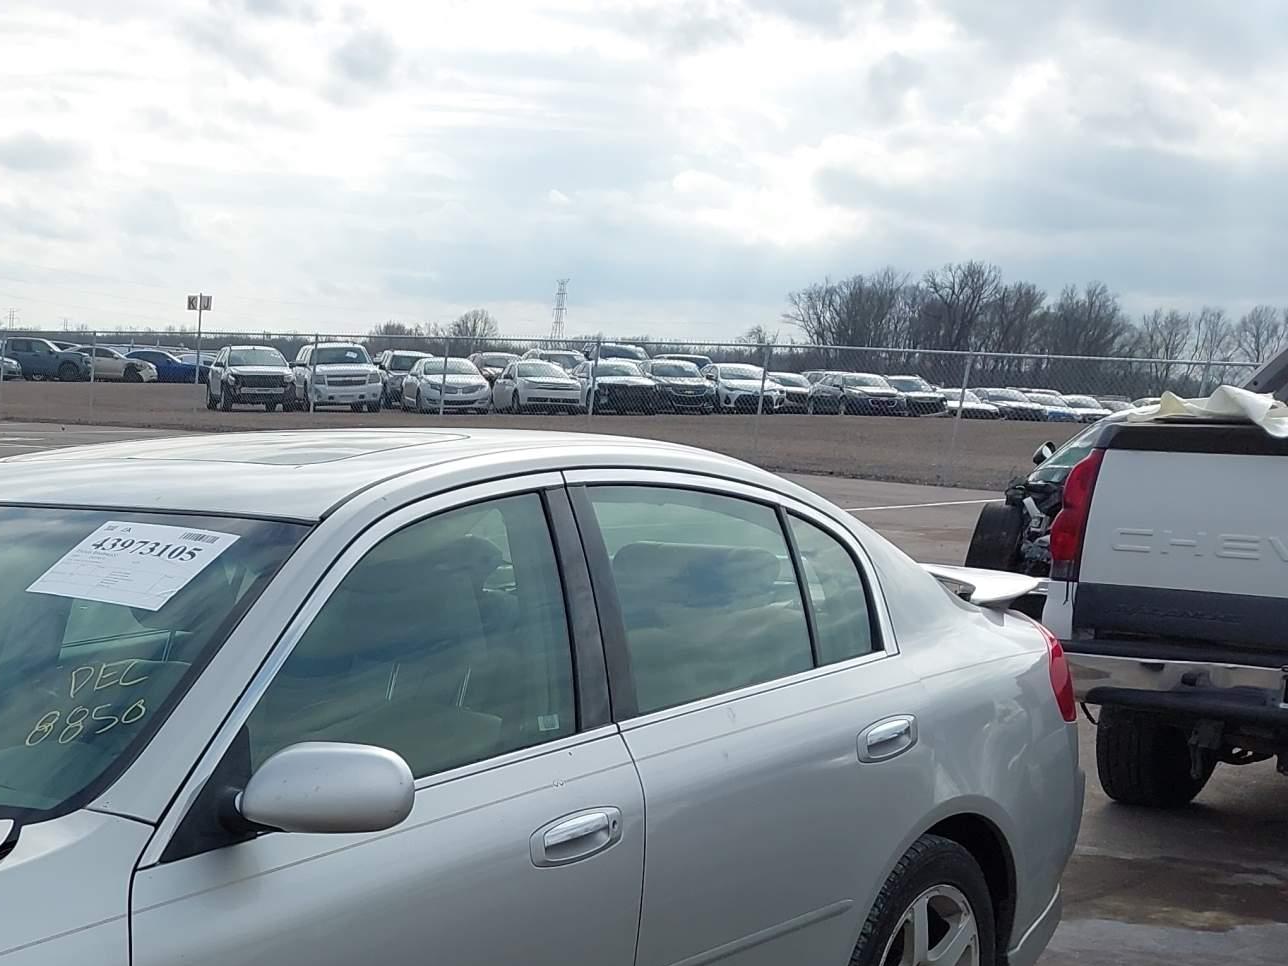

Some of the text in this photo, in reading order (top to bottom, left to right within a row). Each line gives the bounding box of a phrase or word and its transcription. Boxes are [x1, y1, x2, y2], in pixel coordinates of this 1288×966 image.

[92, 536, 203, 561] 43973105
[69, 659, 149, 699] DEC
[25, 699, 146, 746] 8850
